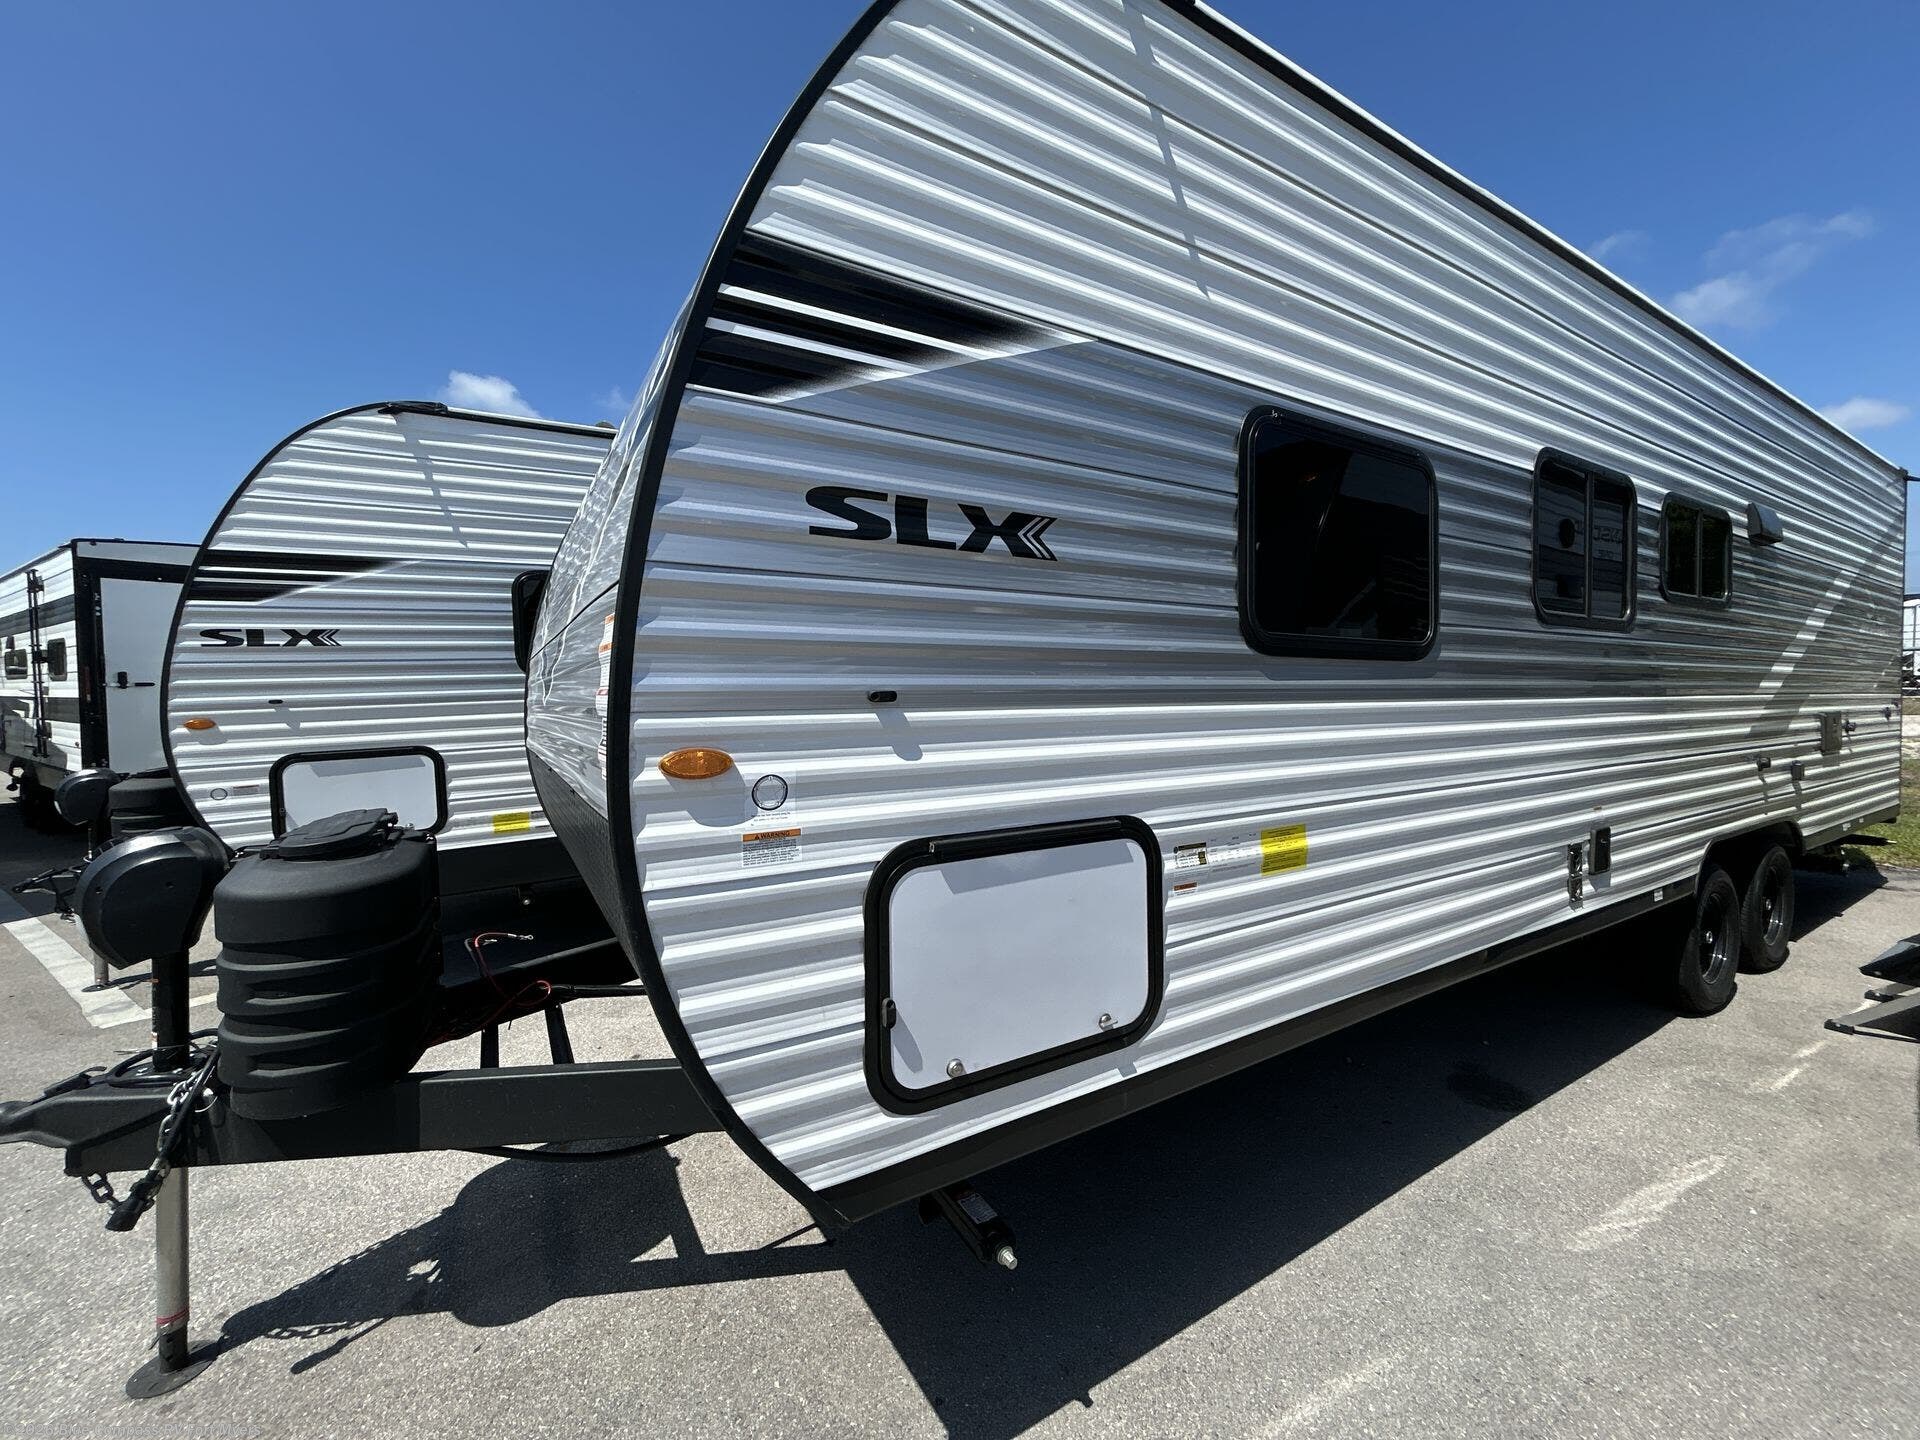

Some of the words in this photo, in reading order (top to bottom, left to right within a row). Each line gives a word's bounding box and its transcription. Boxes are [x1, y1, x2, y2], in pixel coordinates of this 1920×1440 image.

[806, 486, 1057, 561] SLX
[200, 629, 341, 647] SLX
[761, 830, 790, 839] WARNING
